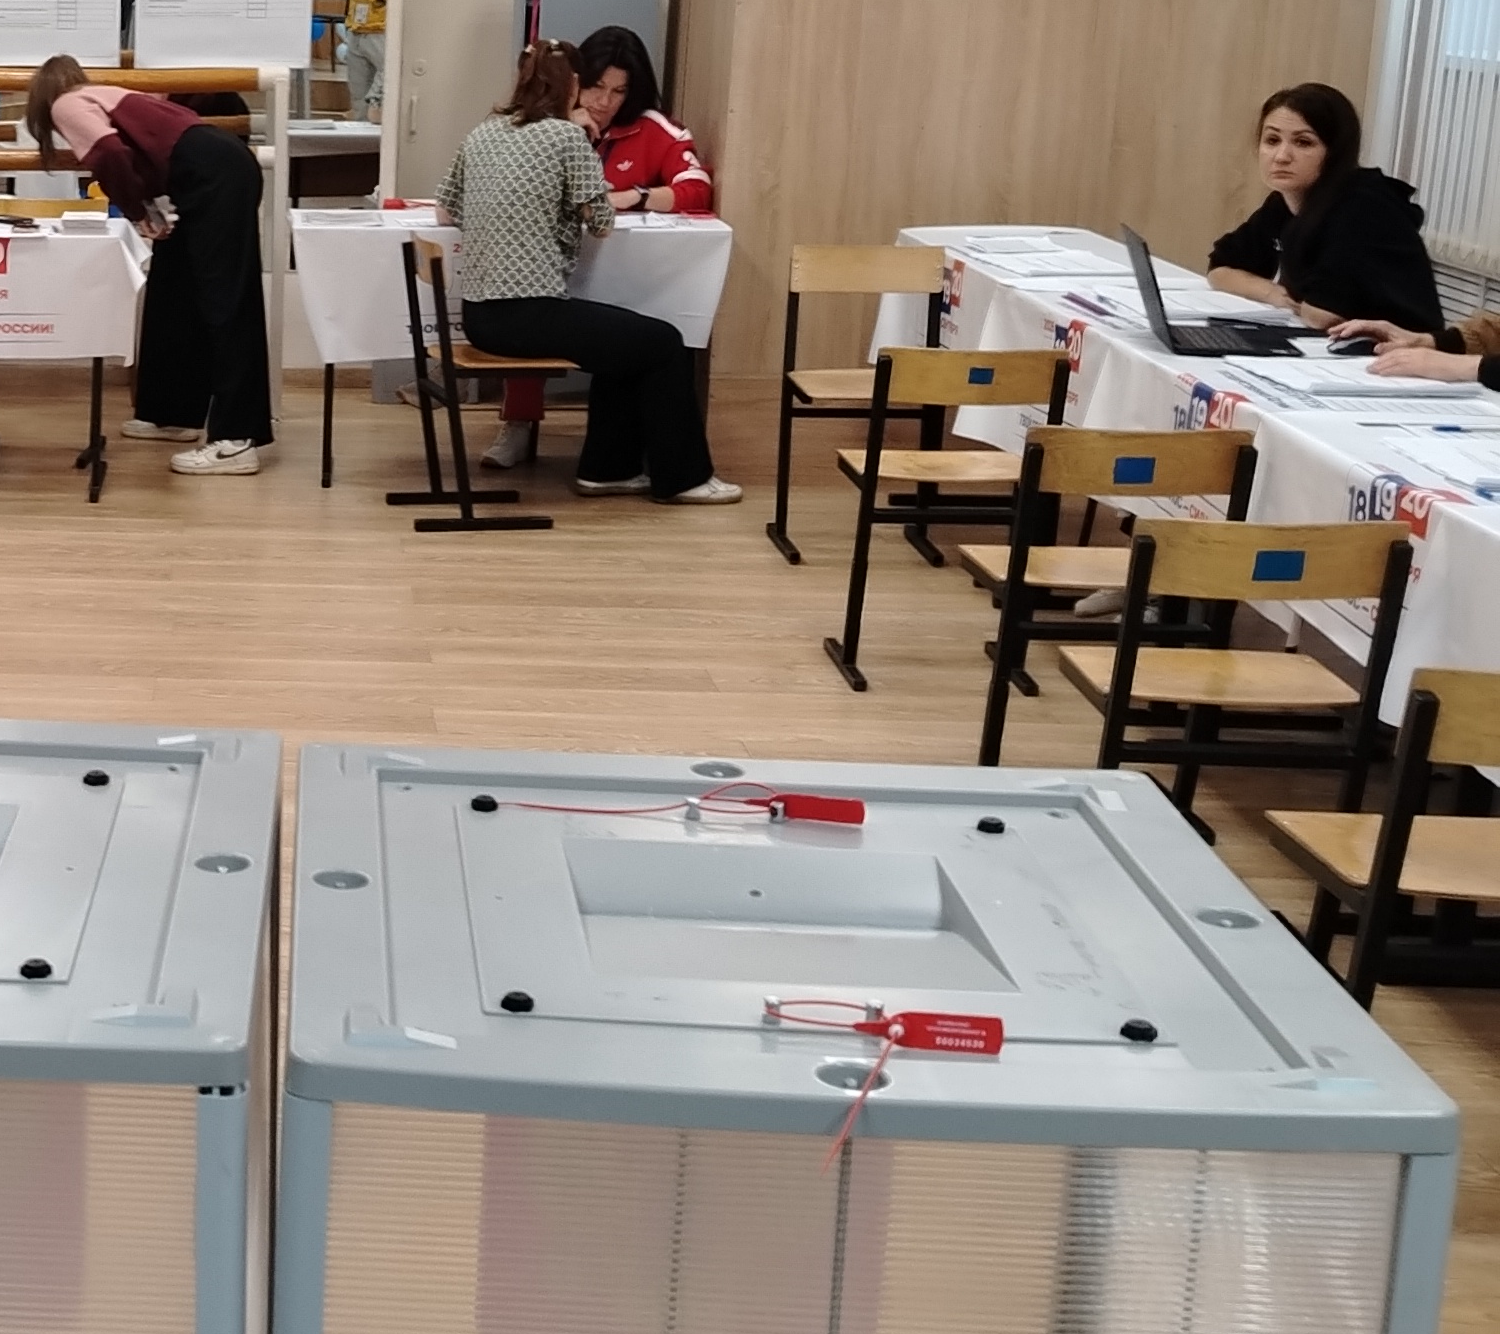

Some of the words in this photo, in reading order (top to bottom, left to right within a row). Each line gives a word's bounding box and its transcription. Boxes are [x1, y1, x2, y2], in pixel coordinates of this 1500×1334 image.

[1192, 396, 1208, 430] 19
[1209, 392, 1234, 429] 20
[1349, 485, 1367, 521] 18
[1373, 478, 1398, 521] 19
